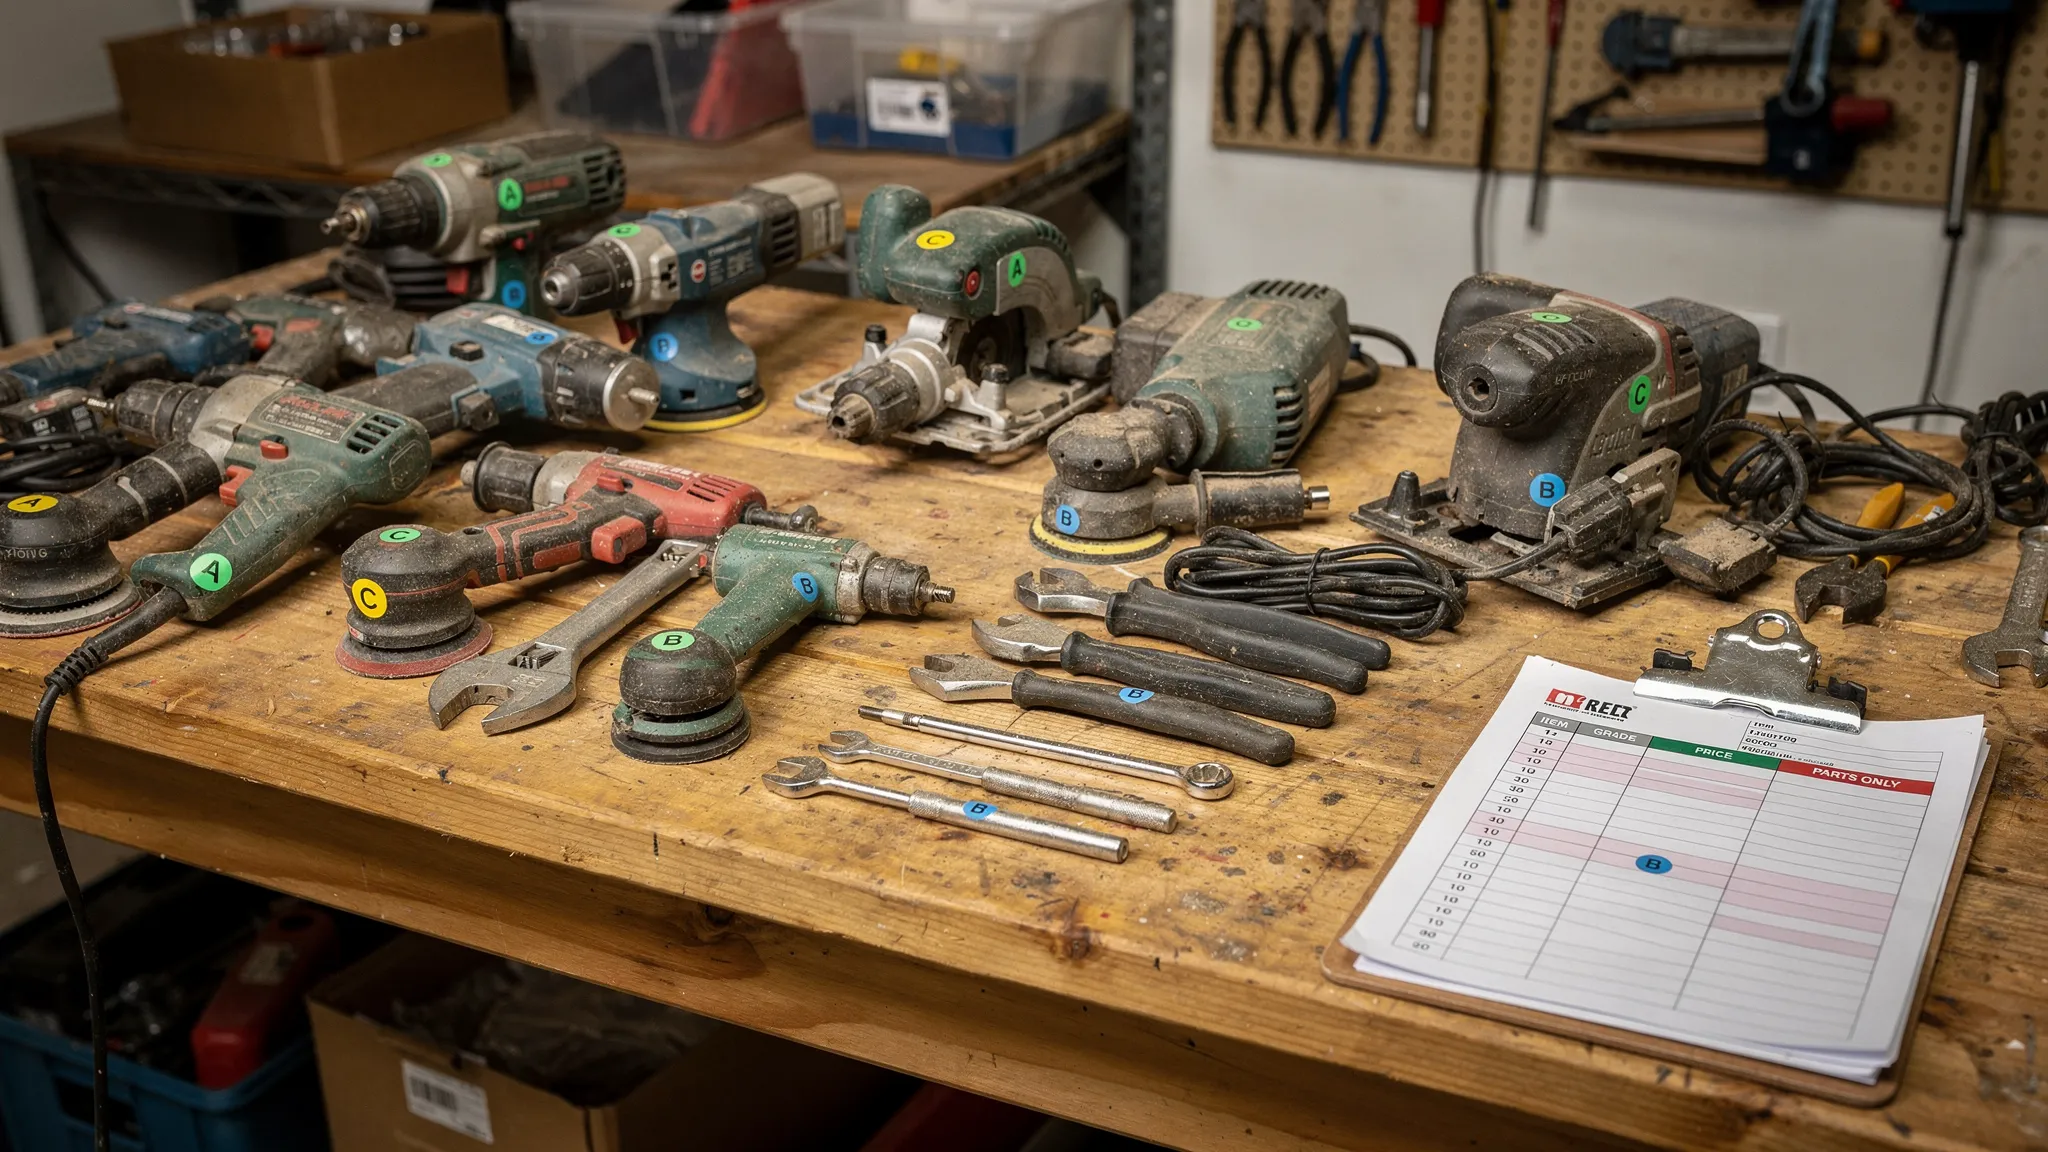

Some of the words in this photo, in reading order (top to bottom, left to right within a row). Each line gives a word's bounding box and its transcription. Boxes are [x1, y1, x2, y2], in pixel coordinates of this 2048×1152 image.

[506, 185, 516, 203] A
[926, 235, 945, 245] C
[1012, 259, 1022, 278] A
[1634, 383, 1646, 405] C
[1540, 481, 1555, 498] B
[17, 498, 42, 507] A
[1061, 510, 1072, 526] B
[389, 530, 410, 539] C
[201, 559, 219, 584] A
[800, 578, 813, 594] B
[360, 587, 377, 609] C
[663, 635, 682, 646] B
[1127, 689, 1145, 698] B
[1593, 728, 1638, 742] GRADE
[1695, 747, 1734, 760] PRICE
[1812, 767, 1858, 782] PARTS
[1861, 776, 1901, 789] ONLY
[970, 803, 988, 814] B
[1463, 860, 1479, 869] 10
[1646, 858, 1661, 869] B
[1456, 872, 1472, 881] 10
[1450, 883, 1465, 892] 10
[1443, 895, 1459, 904] 10
[1435, 906, 1452, 915] 10
[1428, 917, 1444, 926] 10
